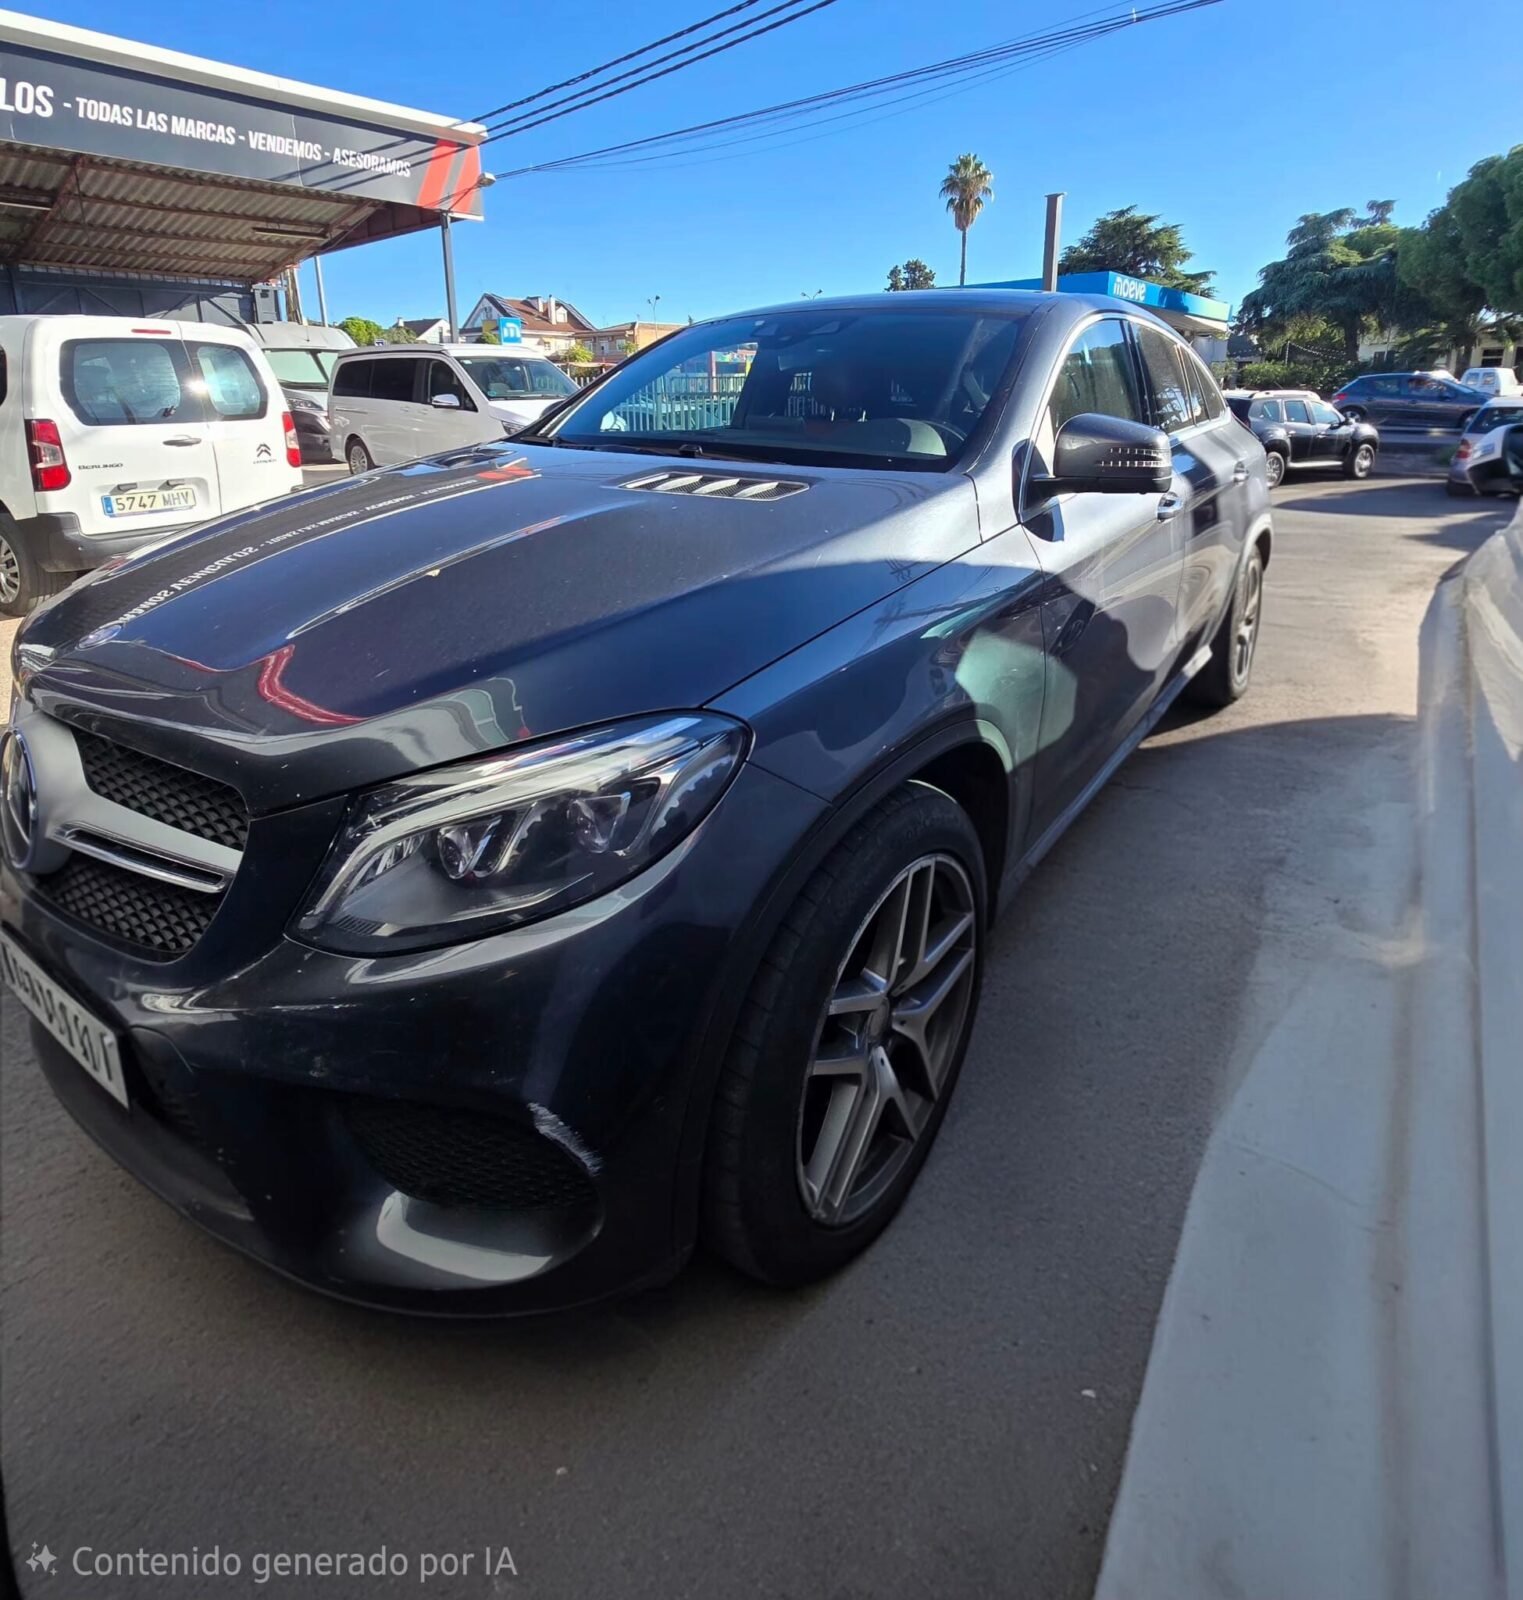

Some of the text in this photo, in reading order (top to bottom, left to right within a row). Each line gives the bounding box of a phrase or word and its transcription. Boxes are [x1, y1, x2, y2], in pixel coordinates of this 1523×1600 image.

[0, 77, 54, 118] LOS
[76, 97, 133, 127] TODAS
[136, 109, 168, 134] LAS
[171, 116, 236, 145] MARCAS
[248, 131, 322, 161] VENDEMOS
[332, 148, 412, 178] ASESORAMOS
[1113, 276, 1146, 301] moeve
[115, 491, 189, 511] 5747 MHV
